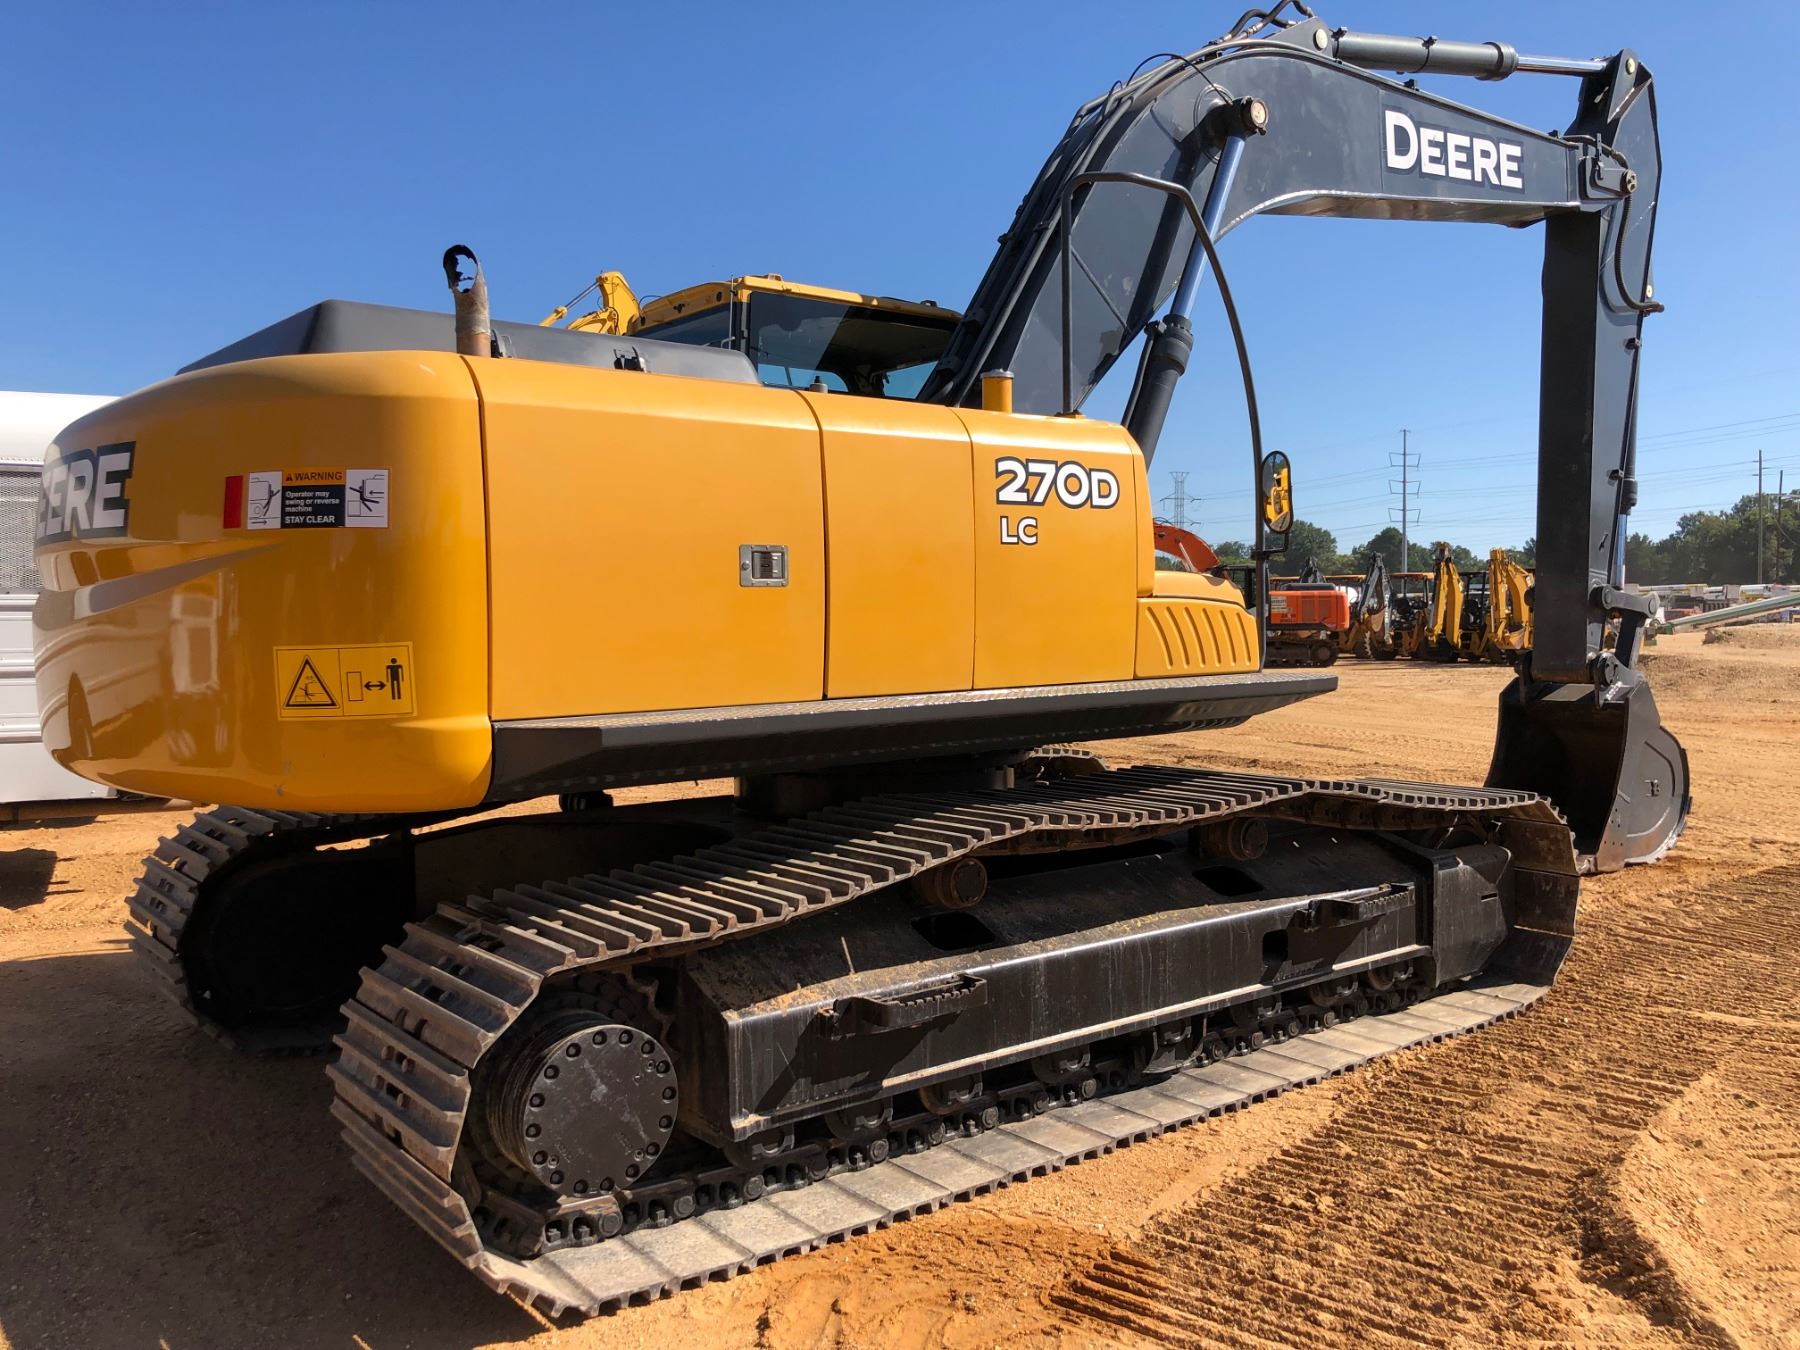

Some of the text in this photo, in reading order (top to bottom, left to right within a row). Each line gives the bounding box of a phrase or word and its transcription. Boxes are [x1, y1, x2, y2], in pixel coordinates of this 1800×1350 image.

[1384, 108, 1524, 190] DEERE
[295, 471, 343, 482] WARNING
[995, 456, 1120, 509] 270D
[285, 490, 330, 499] Operator may
[285, 505, 313, 513] machine
[285, 515, 336, 524] STAY CLEAR
[1000, 515, 1038, 546] LC
